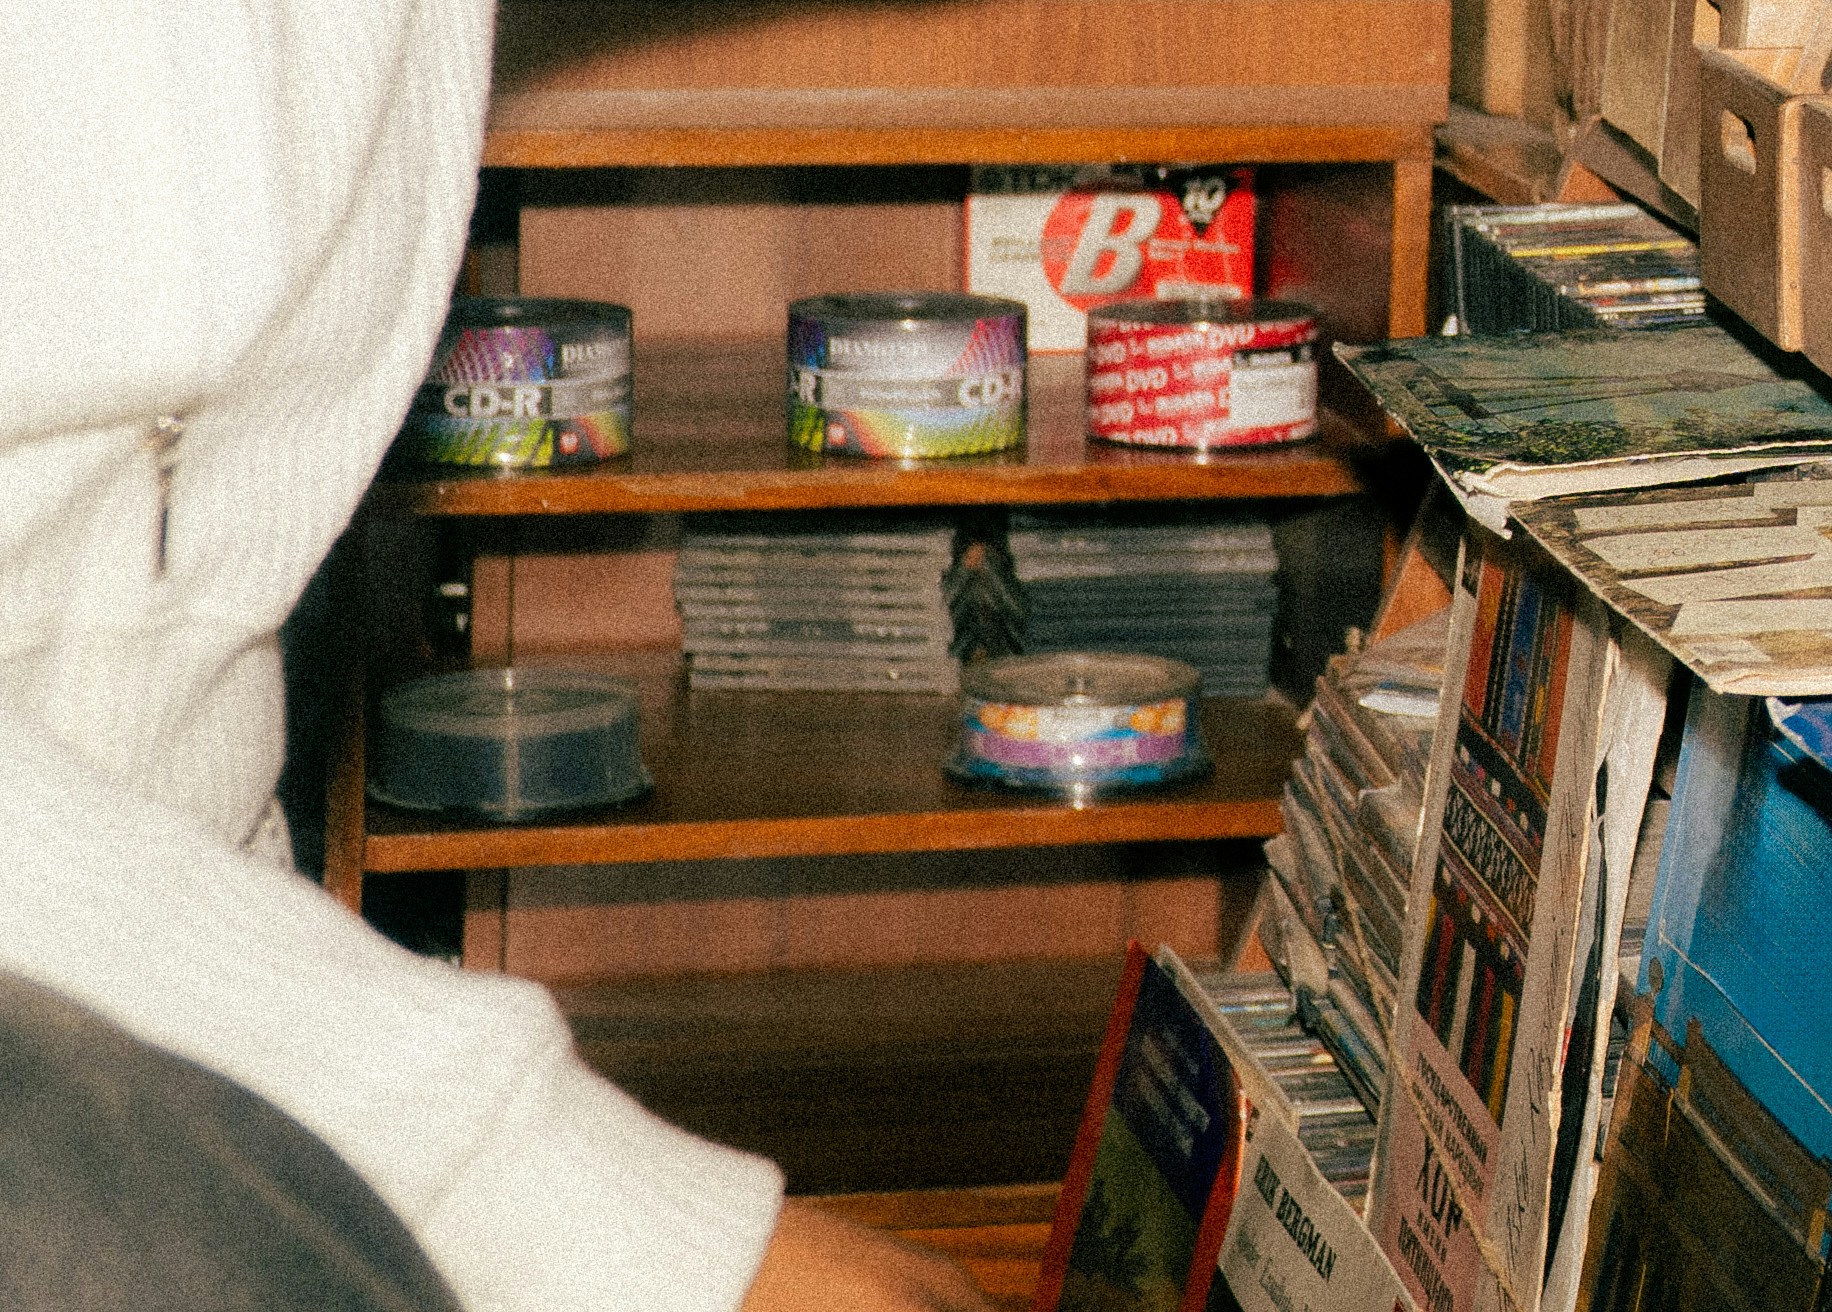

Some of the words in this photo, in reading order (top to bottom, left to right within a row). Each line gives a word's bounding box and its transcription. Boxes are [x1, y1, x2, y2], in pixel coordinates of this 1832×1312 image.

[1060, 192, 1161, 295] B
[443, 384, 543, 418] CD-R
[1275, 1188, 1338, 1281] BERGMAN
